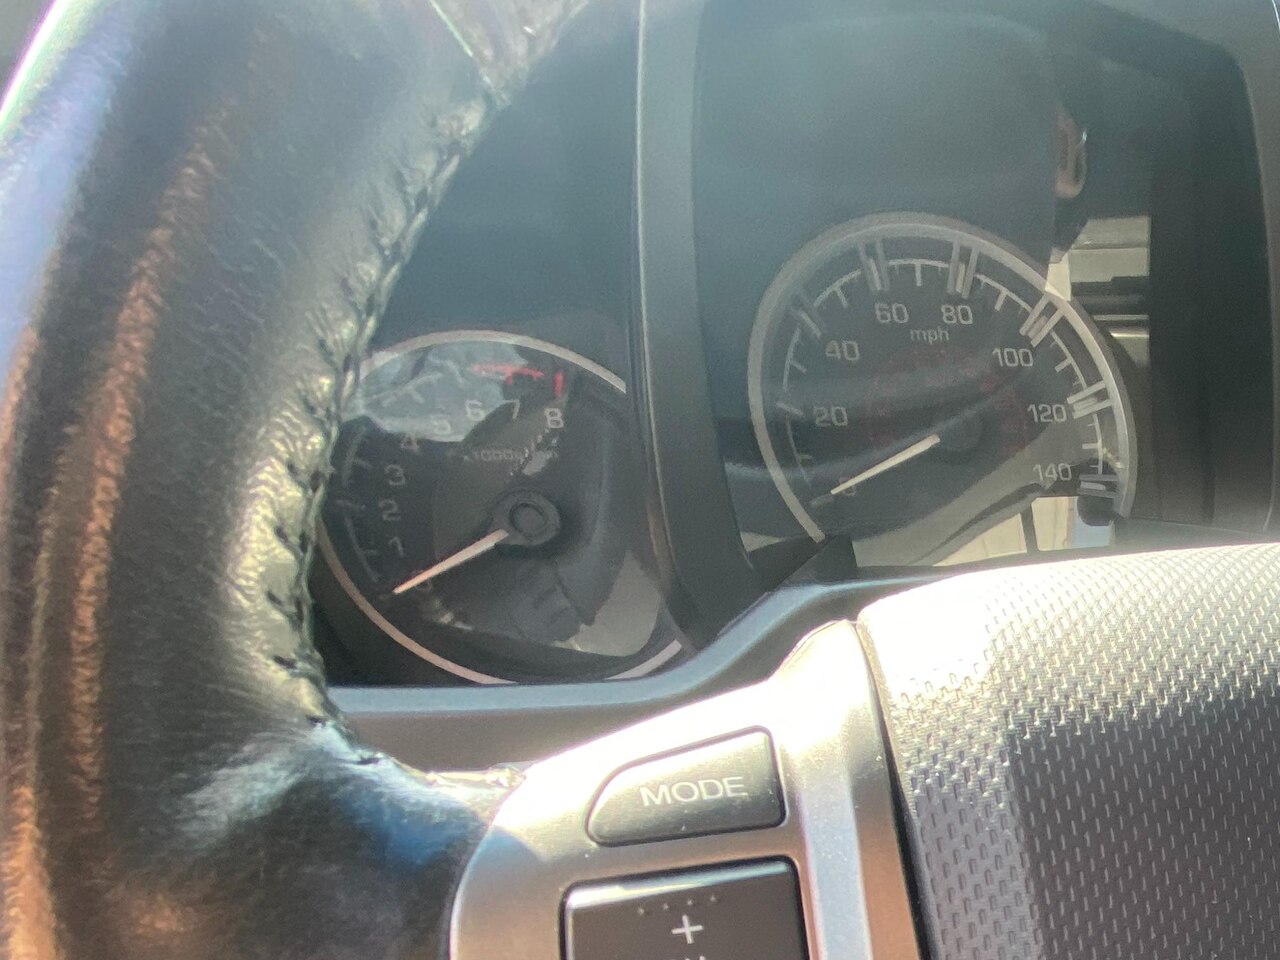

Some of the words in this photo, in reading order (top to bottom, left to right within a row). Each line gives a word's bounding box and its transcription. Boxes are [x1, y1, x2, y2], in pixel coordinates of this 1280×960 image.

[875, 303, 909, 324] 60
[941, 305, 974, 326] 80
[910, 325, 949, 343] mph
[825, 340, 860, 362] 40
[992, 347, 1034, 368] 100
[464, 400, 486, 421] 6
[543, 407, 564, 430] 8
[814, 405, 849, 428] 20
[1027, 403, 1067, 425] 120
[384, 463, 406, 487] 3
[1033, 462, 1073, 483] 140
[378, 499, 401, 522] 2
[388, 535, 404, 556] 1
[638, 775, 748, 808] MODE
